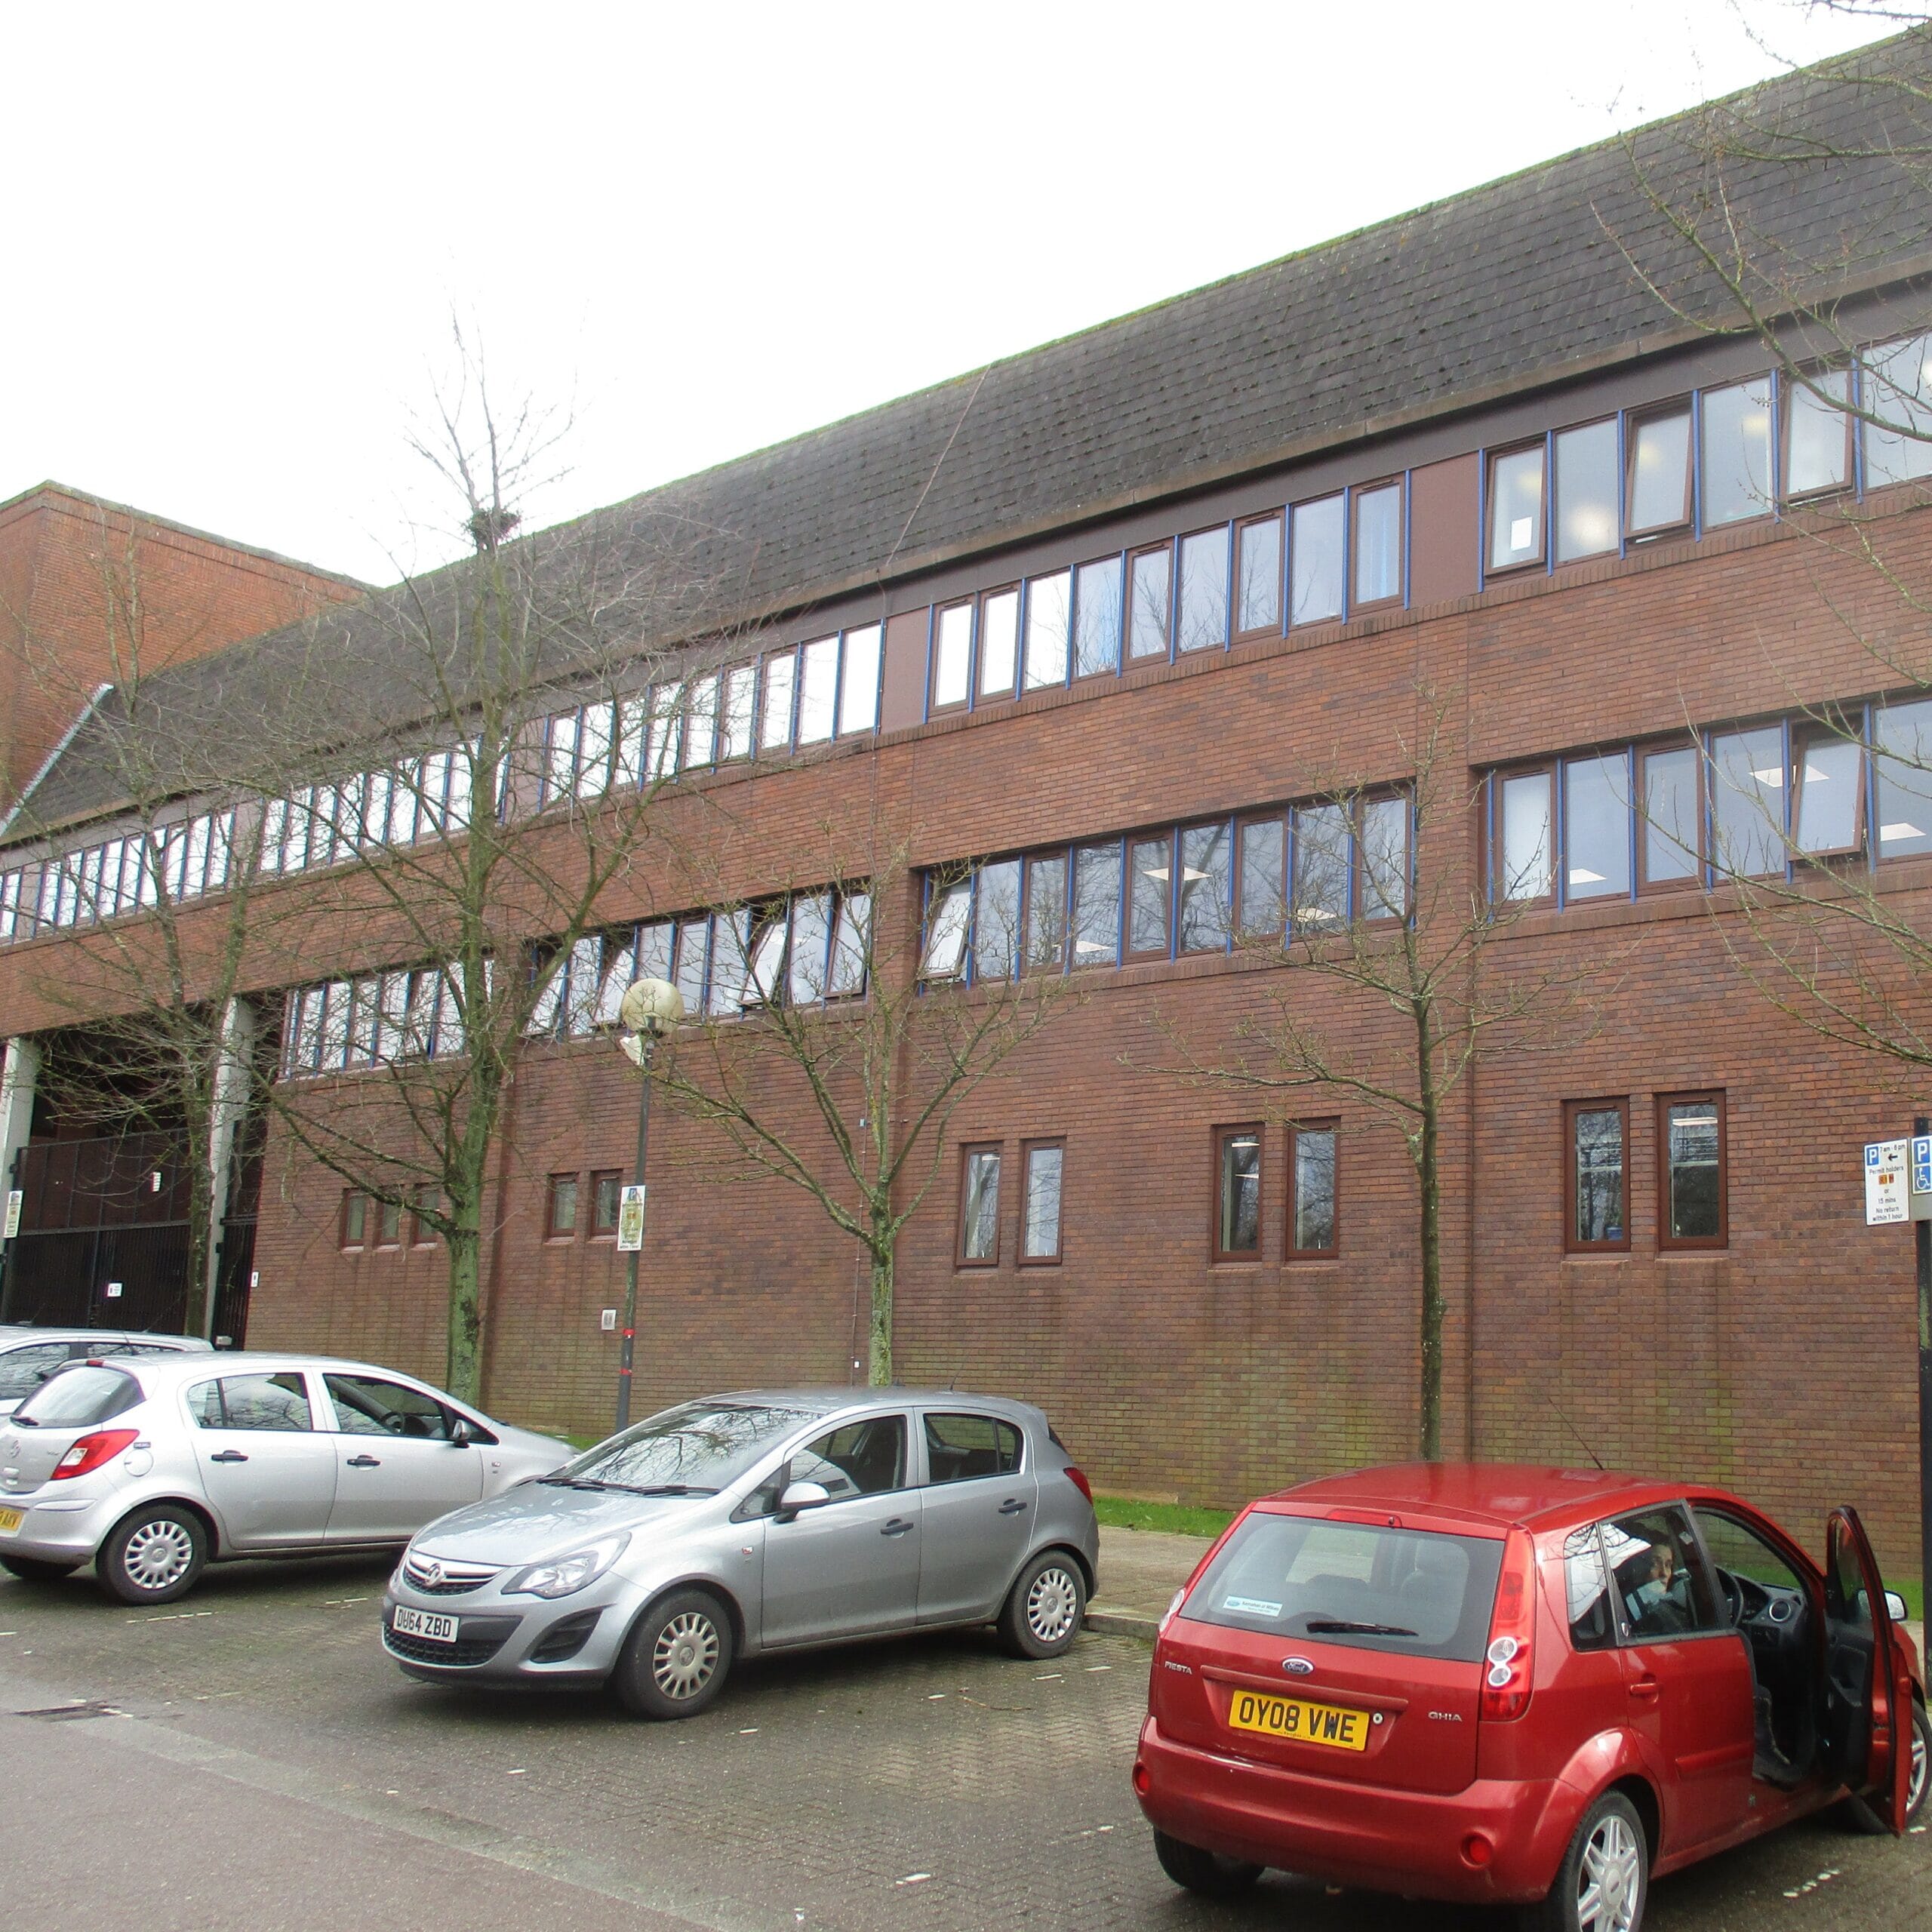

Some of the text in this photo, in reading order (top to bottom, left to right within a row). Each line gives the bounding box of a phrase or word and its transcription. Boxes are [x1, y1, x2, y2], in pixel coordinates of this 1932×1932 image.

[1869, 1149, 1877, 1164] P
[1918, 1143, 1927, 1162] P
[424, 1617, 459, 1638] ZBD
[1164, 1660, 1192, 1675] FIESTA
[1239, 1697, 1357, 1743] OY08 VWE
[1428, 1711, 1463, 1722] GHIA
